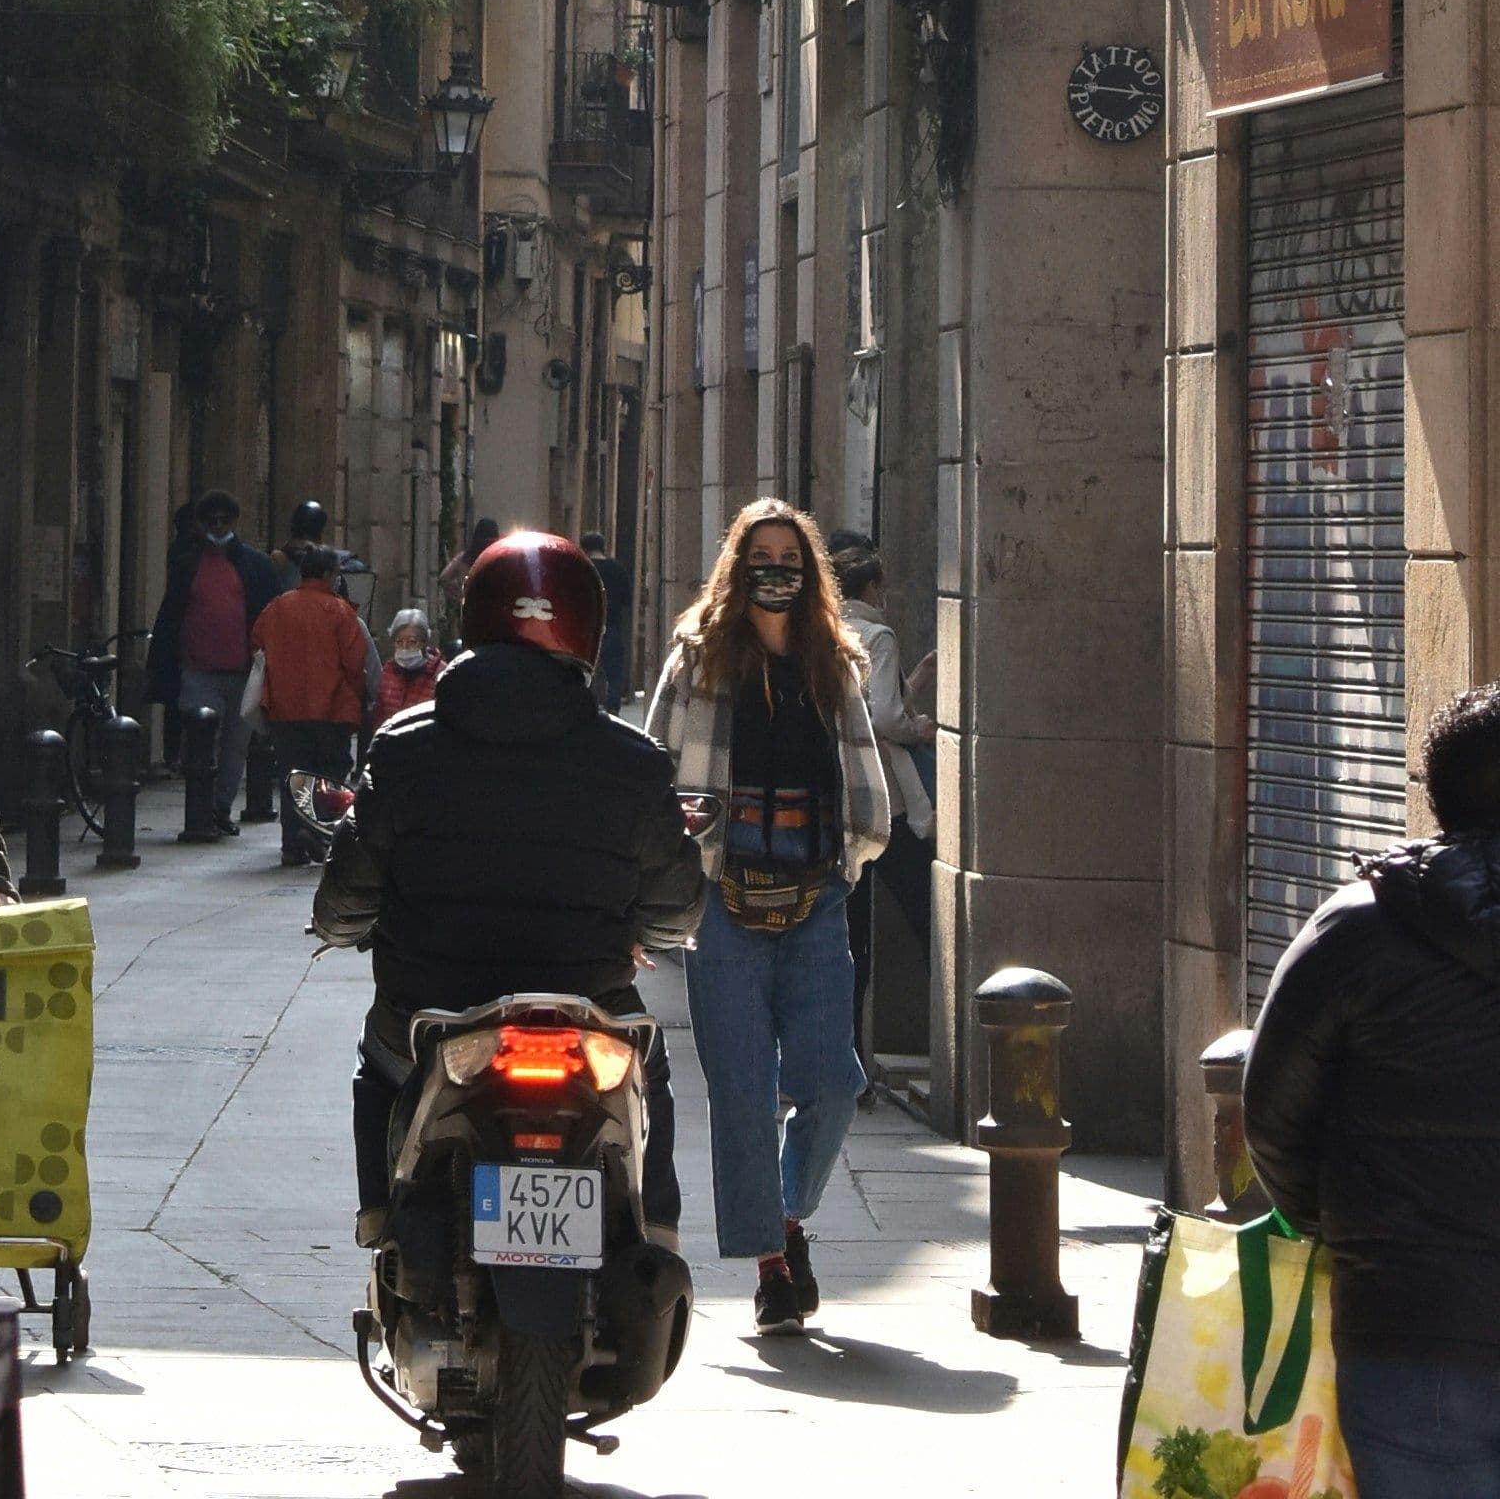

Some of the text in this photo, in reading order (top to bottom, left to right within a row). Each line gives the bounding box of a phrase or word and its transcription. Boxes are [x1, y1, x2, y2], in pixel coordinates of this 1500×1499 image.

[1075, 46, 1160, 86] TATTOO
[1070, 91, 1160, 140] PIERCING
[482, 1198, 493, 1211] E
[509, 1173, 595, 1210] 4570
[507, 1210, 571, 1247] KVK
[495, 1252, 581, 1266] MOTOCAT
